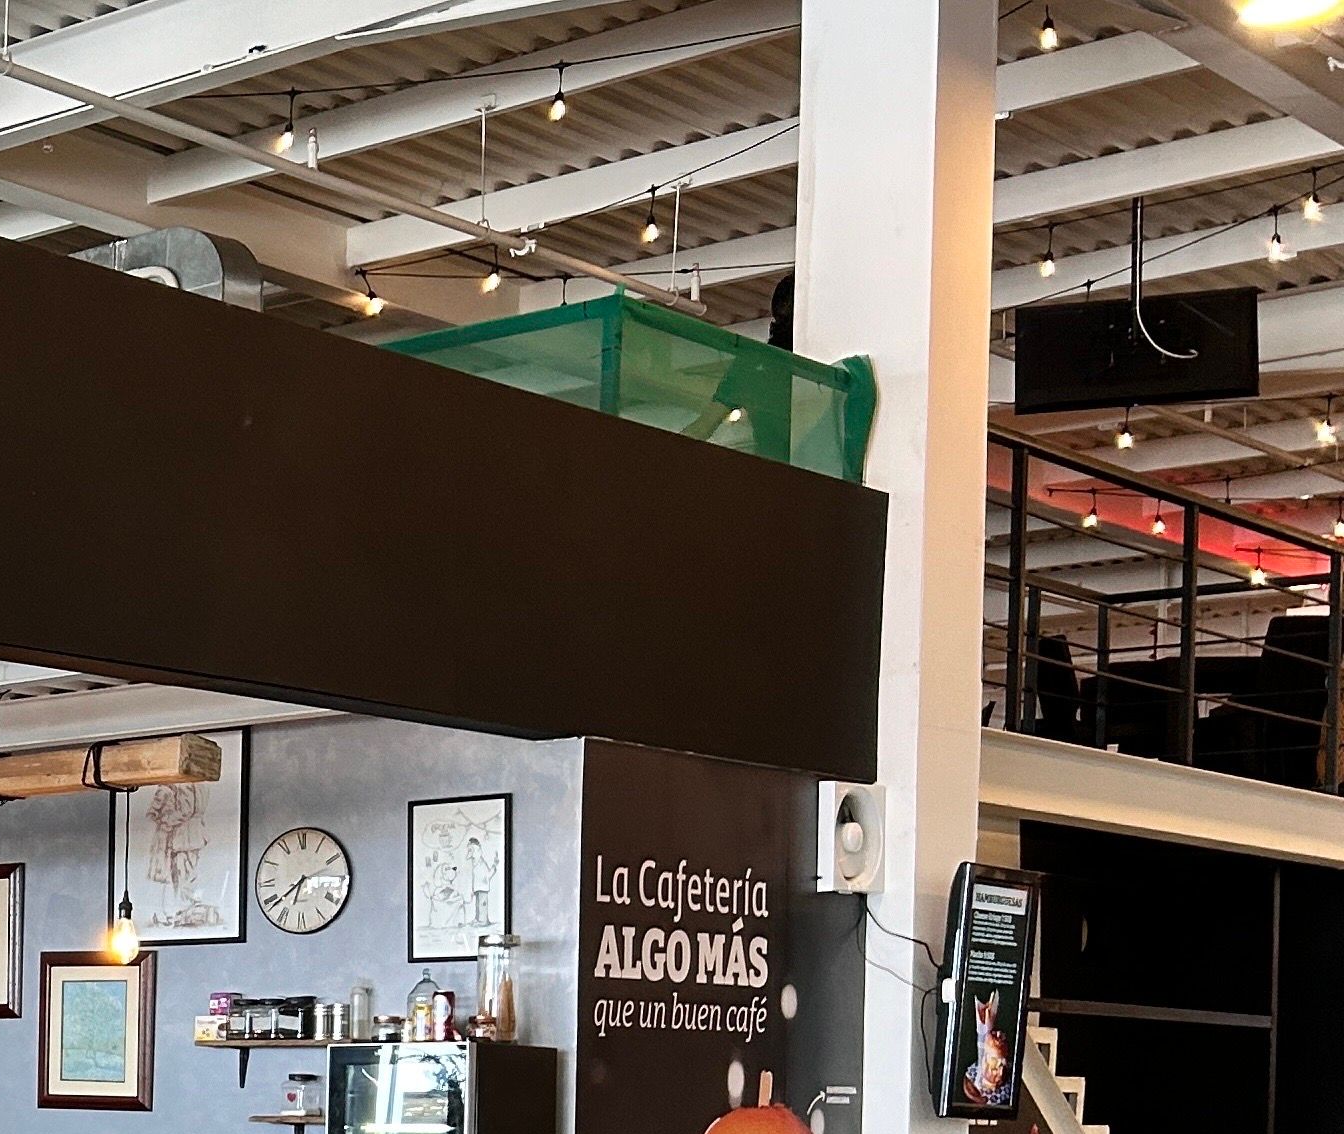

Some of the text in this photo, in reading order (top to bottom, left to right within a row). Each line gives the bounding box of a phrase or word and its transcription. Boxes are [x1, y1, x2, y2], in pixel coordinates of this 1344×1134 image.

[596, 855, 769, 923] La Cafetería
[594, 916, 769, 988] ALGO MÁS
[594, 991, 768, 1043] que un buen café
